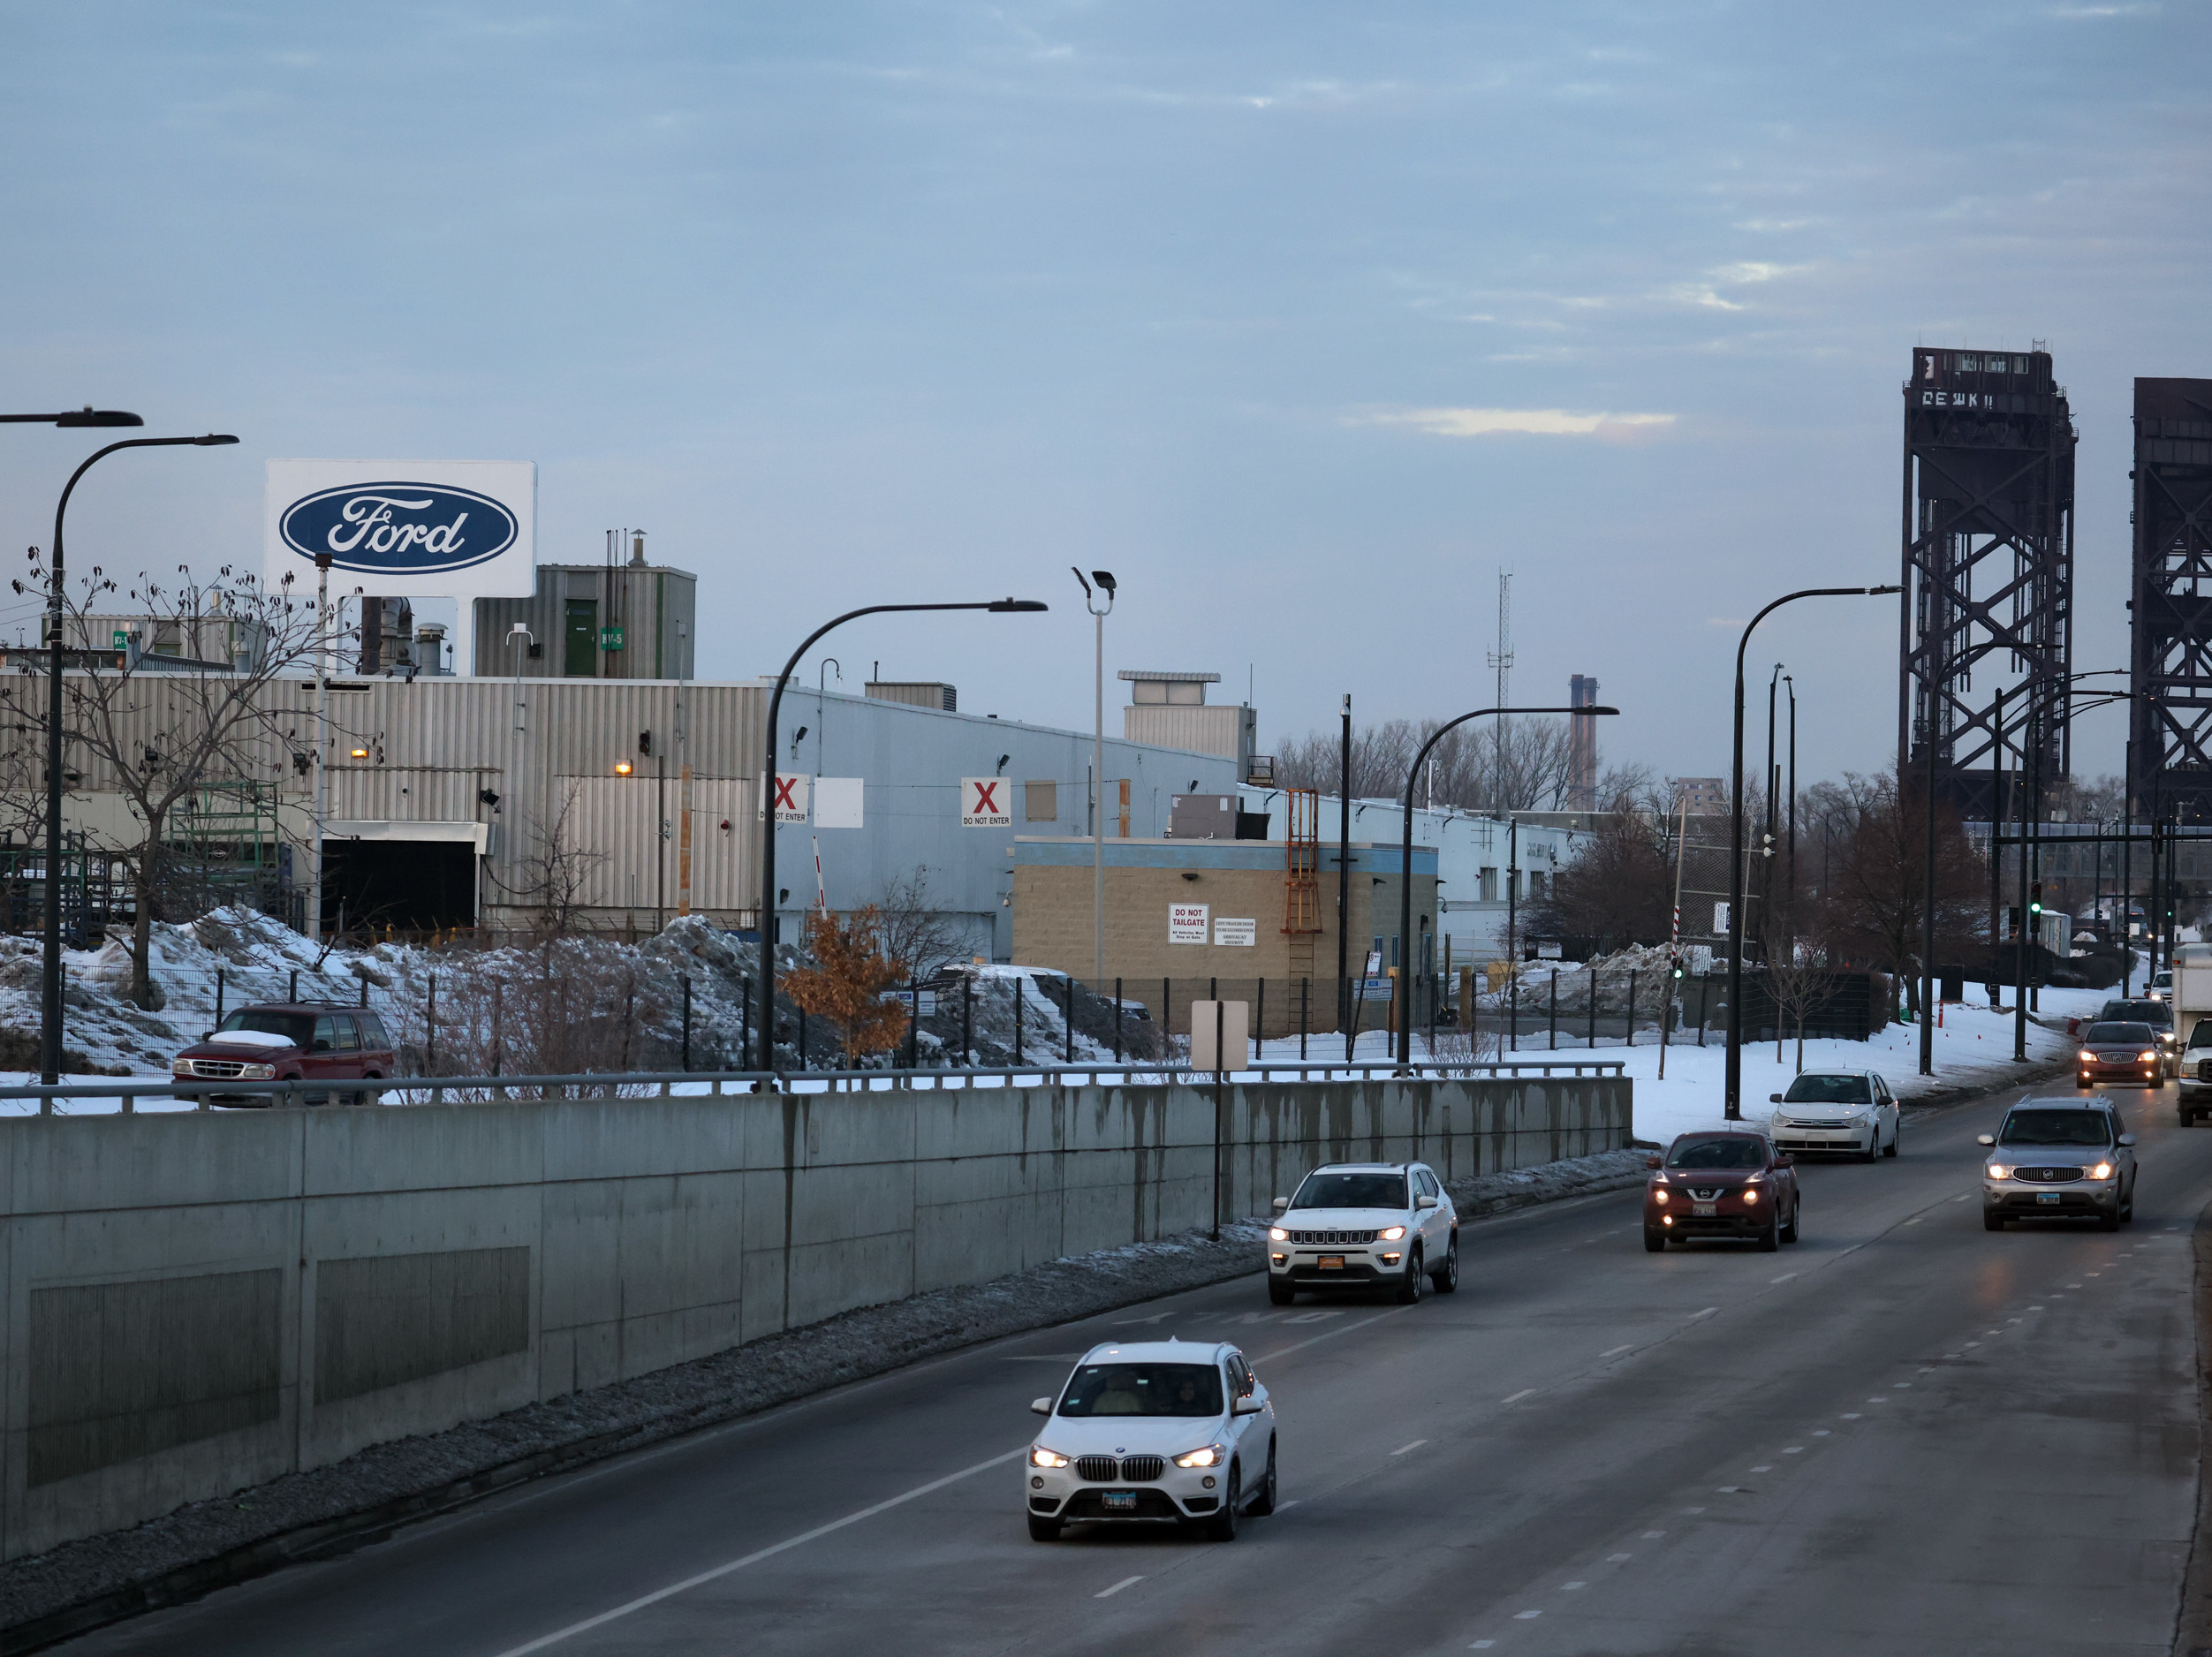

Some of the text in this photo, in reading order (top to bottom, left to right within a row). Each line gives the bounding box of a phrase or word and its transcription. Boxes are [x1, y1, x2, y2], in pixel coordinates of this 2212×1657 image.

[327, 496, 469, 554] Ford
[775, 777, 798, 810] X
[973, 782, 999, 813] X
[785, 813, 806, 821] ENTER
[989, 816, 1010, 825] ENTER
[1172, 918, 1205, 927] TAILGATE
